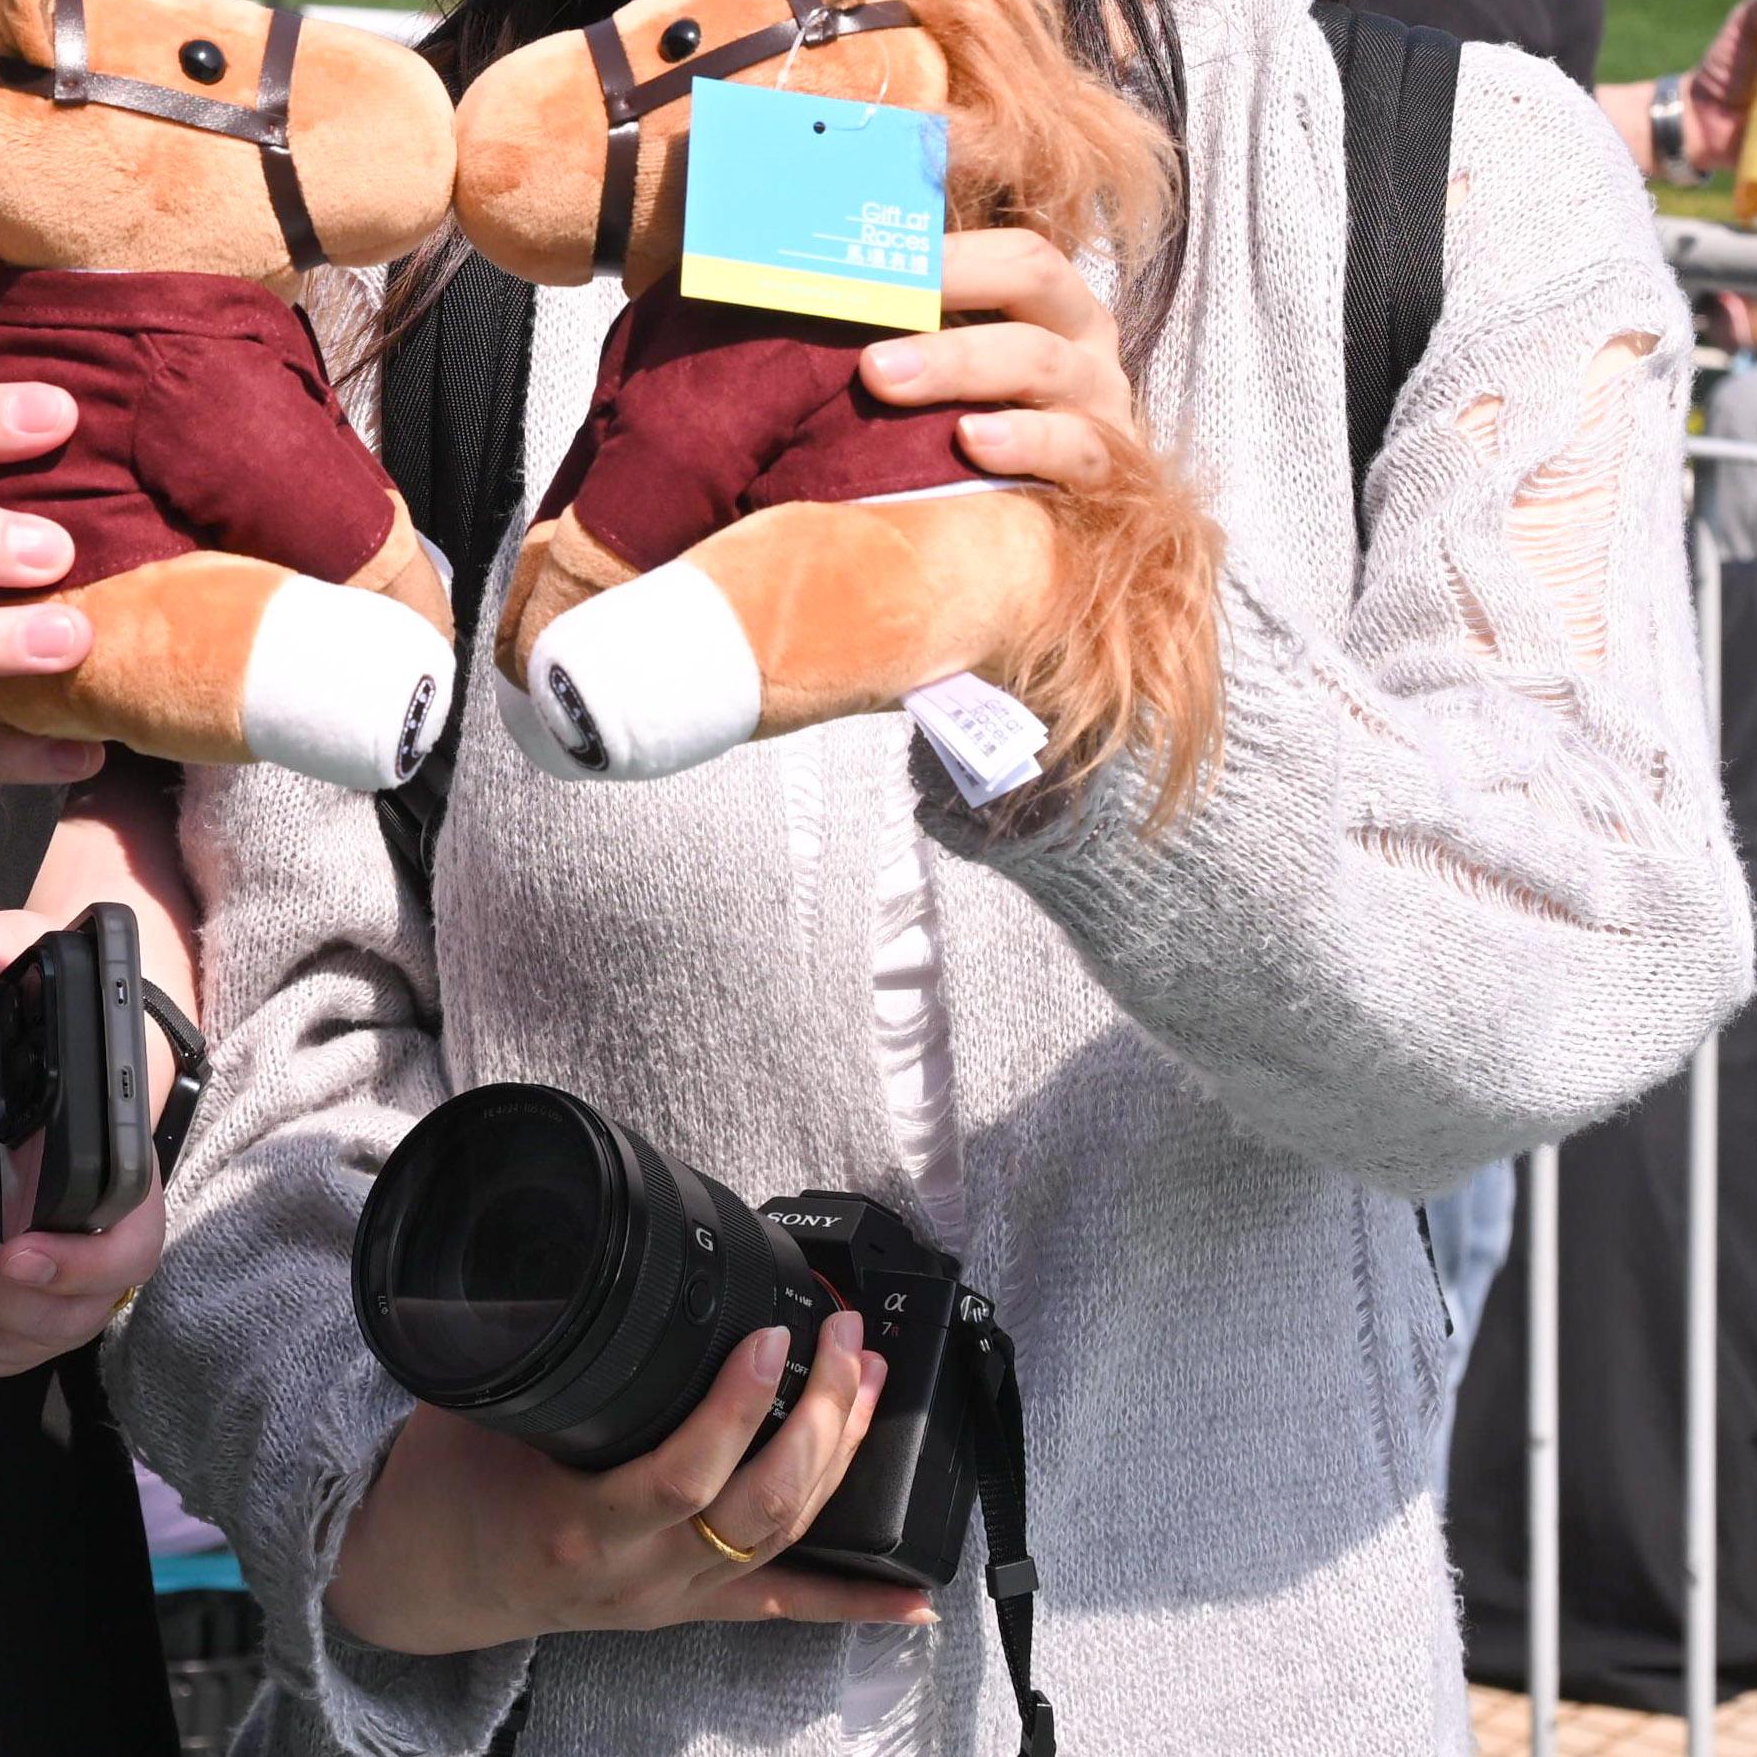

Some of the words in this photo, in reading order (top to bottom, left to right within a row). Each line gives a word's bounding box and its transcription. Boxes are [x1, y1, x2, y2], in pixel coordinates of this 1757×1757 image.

[862, 202, 901, 227] Gift
[906, 211, 931, 231] at
[862, 223, 930, 252] Races
[766, 1211, 843, 1228] SONY
[696, 1227, 714, 1252] G
[794, 1363, 809, 1376] OFF
